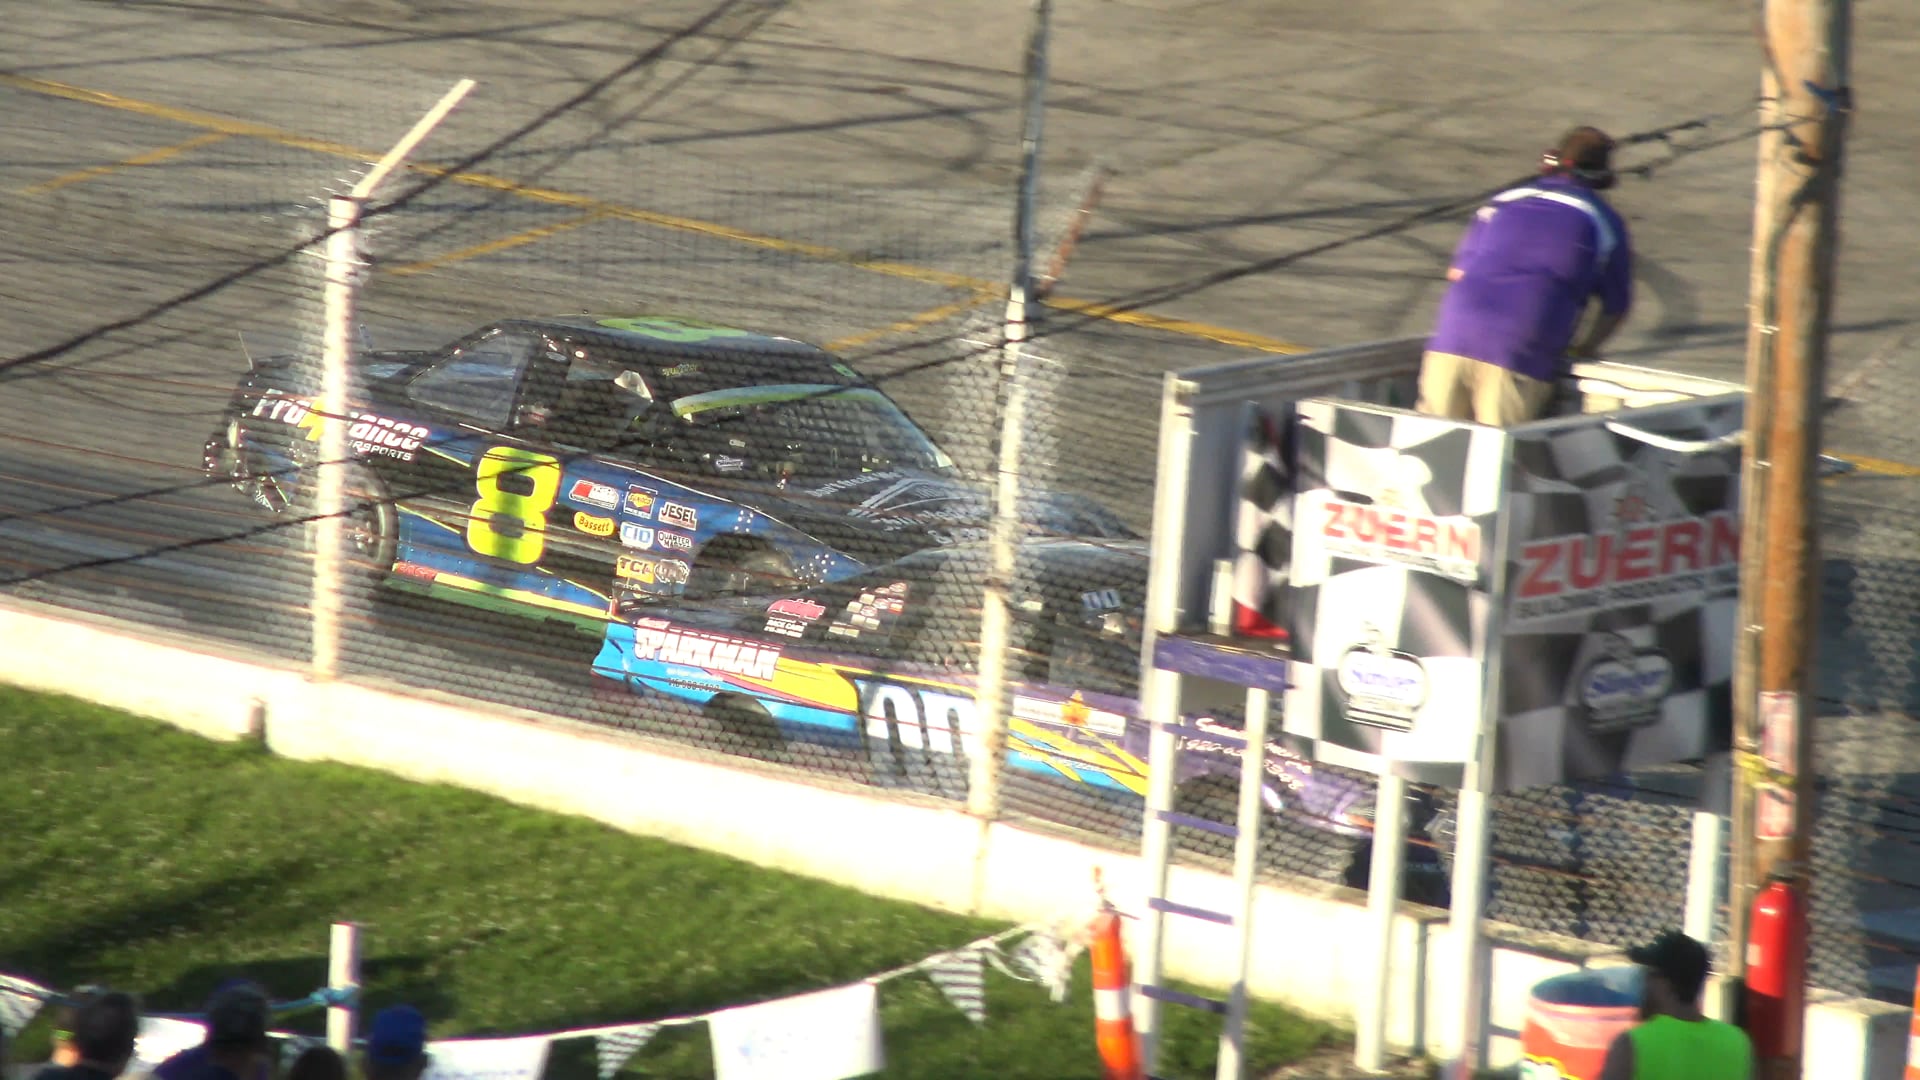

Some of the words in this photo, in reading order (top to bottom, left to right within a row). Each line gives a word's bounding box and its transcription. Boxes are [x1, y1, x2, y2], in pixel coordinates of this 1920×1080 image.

[466, 446, 561, 565] 8
[578, 516, 610, 533] Bassett
[660, 503, 697, 523] JESEL
[624, 525, 651, 544] CID
[658, 532, 690, 546] QUARTER
[1323, 502, 1480, 563] ZUERN
[1518, 513, 1741, 598] ZUERN
[634, 616, 783, 682] SPARKMAN
